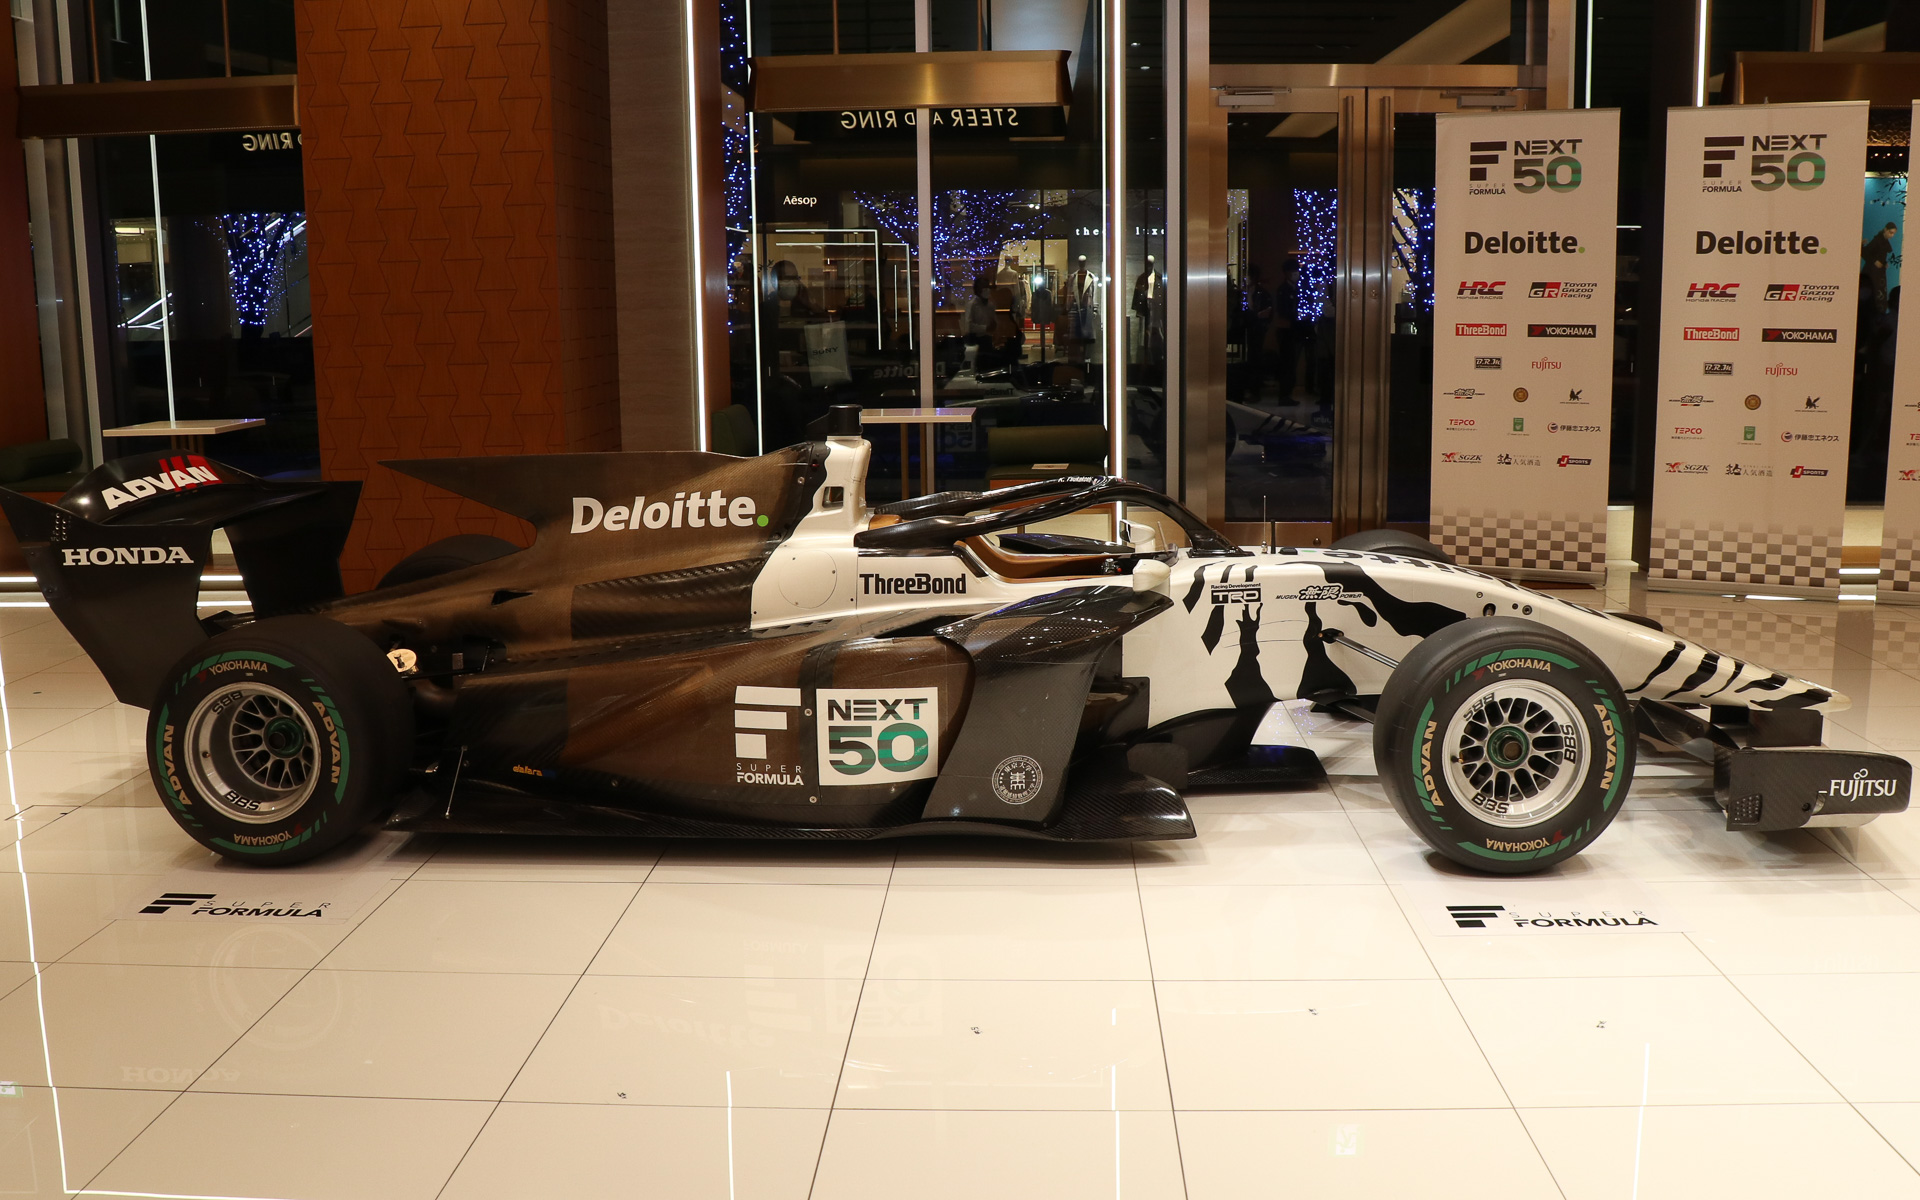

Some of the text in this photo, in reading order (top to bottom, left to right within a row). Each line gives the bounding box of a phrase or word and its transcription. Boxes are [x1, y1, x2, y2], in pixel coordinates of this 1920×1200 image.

[1514, 139, 1582, 156] NEXT
[1752, 134, 1827, 151] NEXT
[1513, 156, 1582, 194] 50
[1751, 152, 1826, 191] 50
[1465, 231, 1586, 254] Deloitte.
[1696, 230, 1828, 255] Deloitte.
[1457, 281, 1506, 296] HRC
[1686, 283, 1740, 298] HRC
[1456, 324, 1506, 336] ThreeBond
[1545, 327, 1594, 335] YOKOHAMA
[1685, 328, 1738, 340] ThreeBond
[1781, 331, 1834, 341] YOKOHAMA
[1531, 357, 1562, 371] FUJITSU
[1765, 362, 1798, 377] FUJITSU
[101, 466, 219, 510] ADVAN
[571, 489, 769, 534] Deloitte.
[62, 546, 194, 566] HONDA
[859, 573, 967, 595] ThreeBond
[1213, 591, 1259, 603] TRD
[209, 660, 268, 676] YOKOHAMA
[1487, 659, 1551, 673] YOKOHAMA
[211, 691, 244, 715] BBS
[827, 698, 929, 721] NEXT
[312, 701, 341, 784] ADVAN
[829, 722, 929, 775] 50
[1560, 722, 1577, 764] BBS
[1593, 703, 1617, 790] ADVAN
[163, 724, 193, 805] ADVAN
[736, 762, 802, 773] SUPER
[1420, 721, 1444, 807] ADVAN
[736, 772, 804, 786] FORMULA
[1829, 768, 1897, 802] FUJITSU
[224, 790, 262, 811] BBS
[1471, 792, 1510, 814] BBS
[233, 830, 293, 846] YOKOHAMA
[1486, 837, 1550, 853] YOKOHAMA
[191, 907, 322, 918] FORMULA
[203, 900, 331, 909] SUPER
[1508, 910, 1646, 919] SUPER
[1513, 917, 1659, 928] FORMULA
